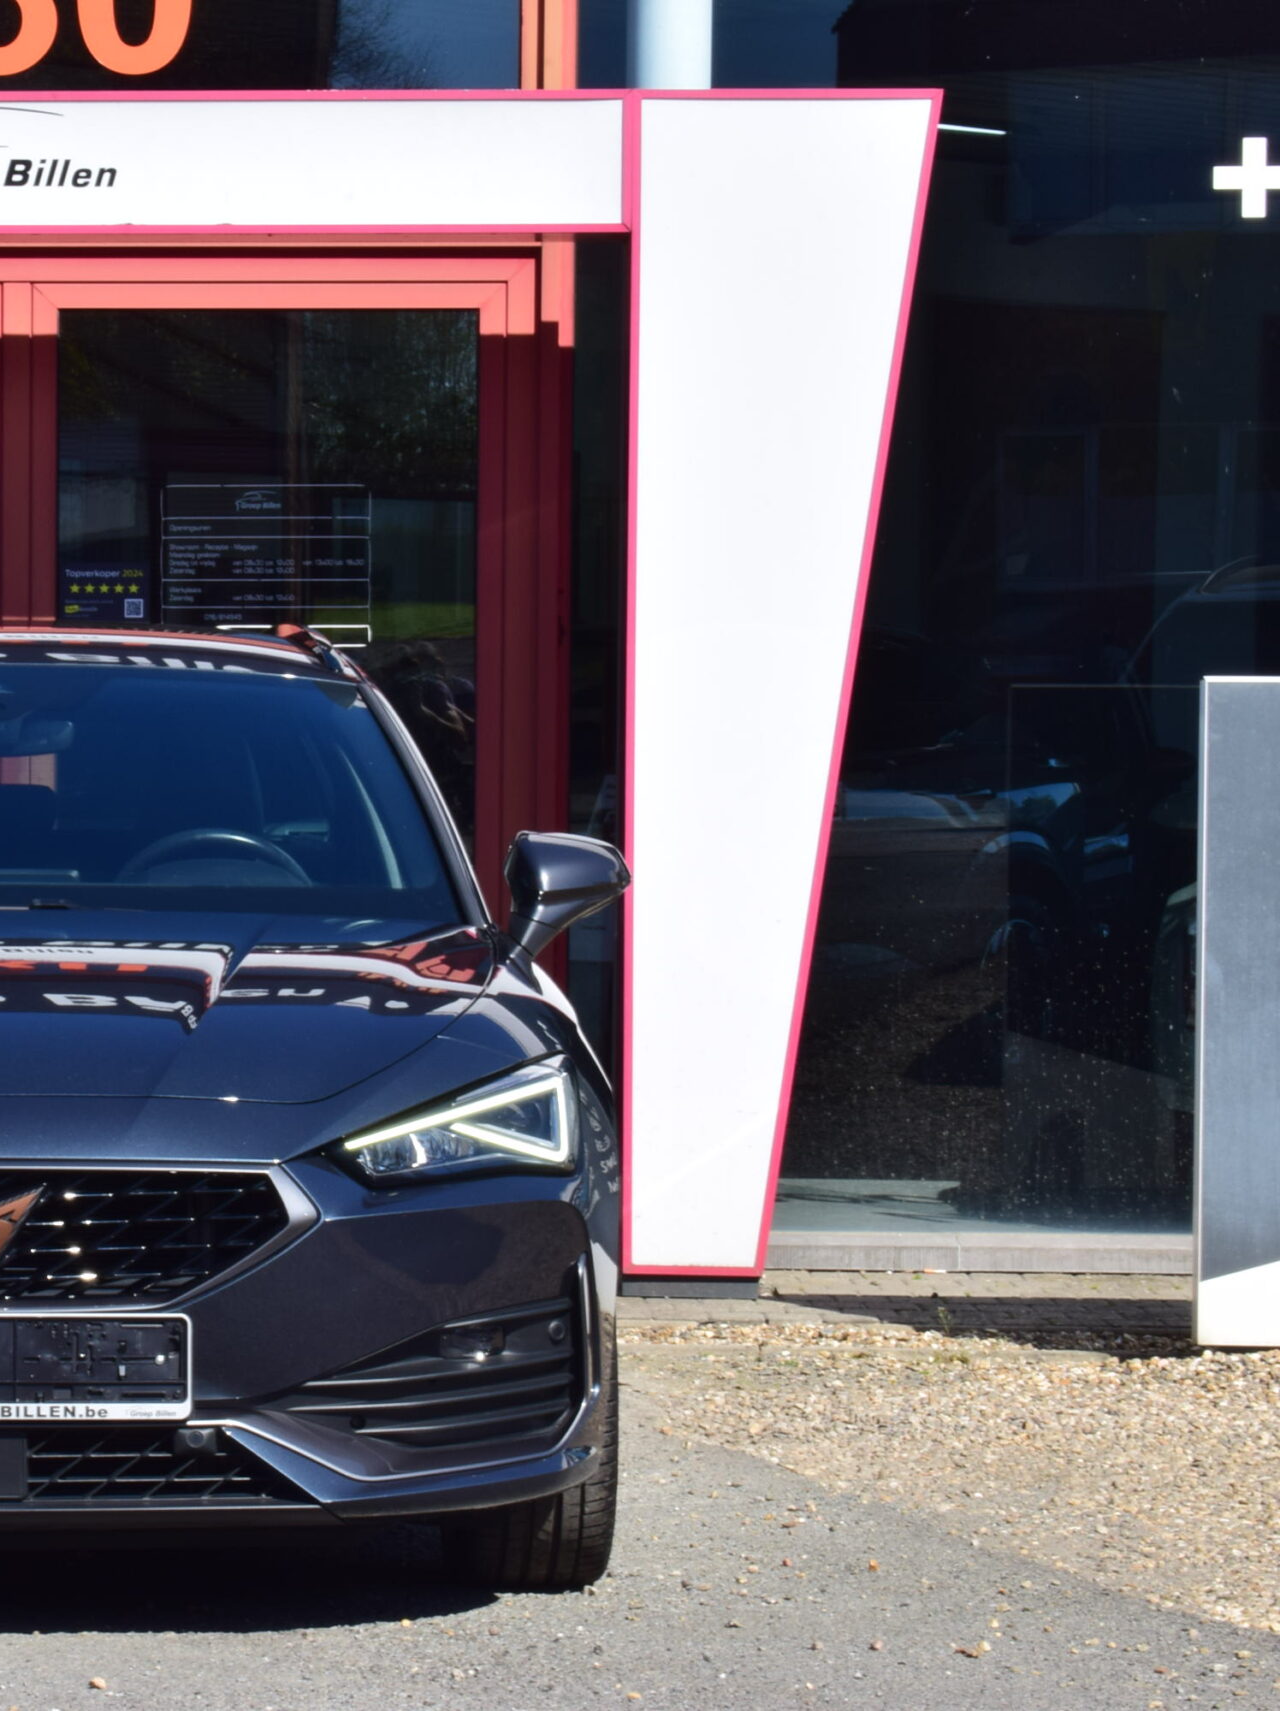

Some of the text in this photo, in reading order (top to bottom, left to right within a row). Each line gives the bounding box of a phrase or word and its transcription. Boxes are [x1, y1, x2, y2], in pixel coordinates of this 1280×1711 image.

[4, 158, 118, 188] Billen
[65, 569, 143, 578] Topverkoper 2024
